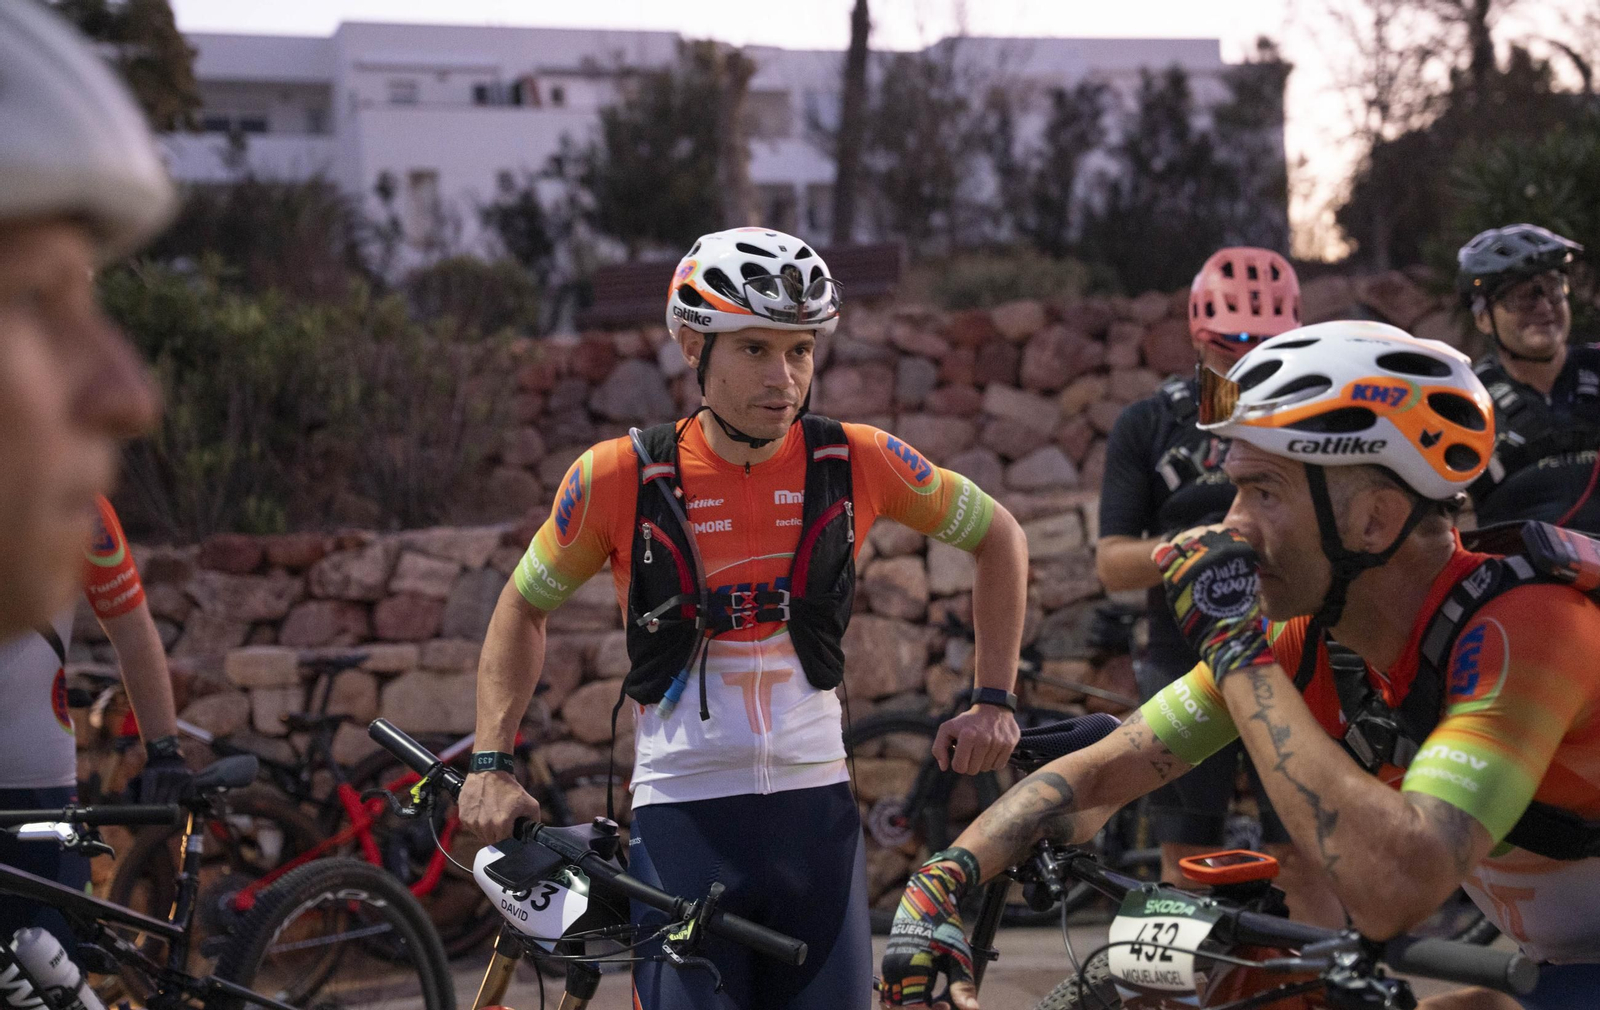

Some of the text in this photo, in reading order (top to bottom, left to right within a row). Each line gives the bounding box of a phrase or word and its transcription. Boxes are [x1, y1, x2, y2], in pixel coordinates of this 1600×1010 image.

[673, 305, 712, 327] catlike
[1286, 436, 1388, 455] catlike
[685, 498, 725, 510] atlike
[694, 519, 733, 534] MORE
[500, 898, 529, 922] DAVID
[1129, 922, 1180, 963] 432
